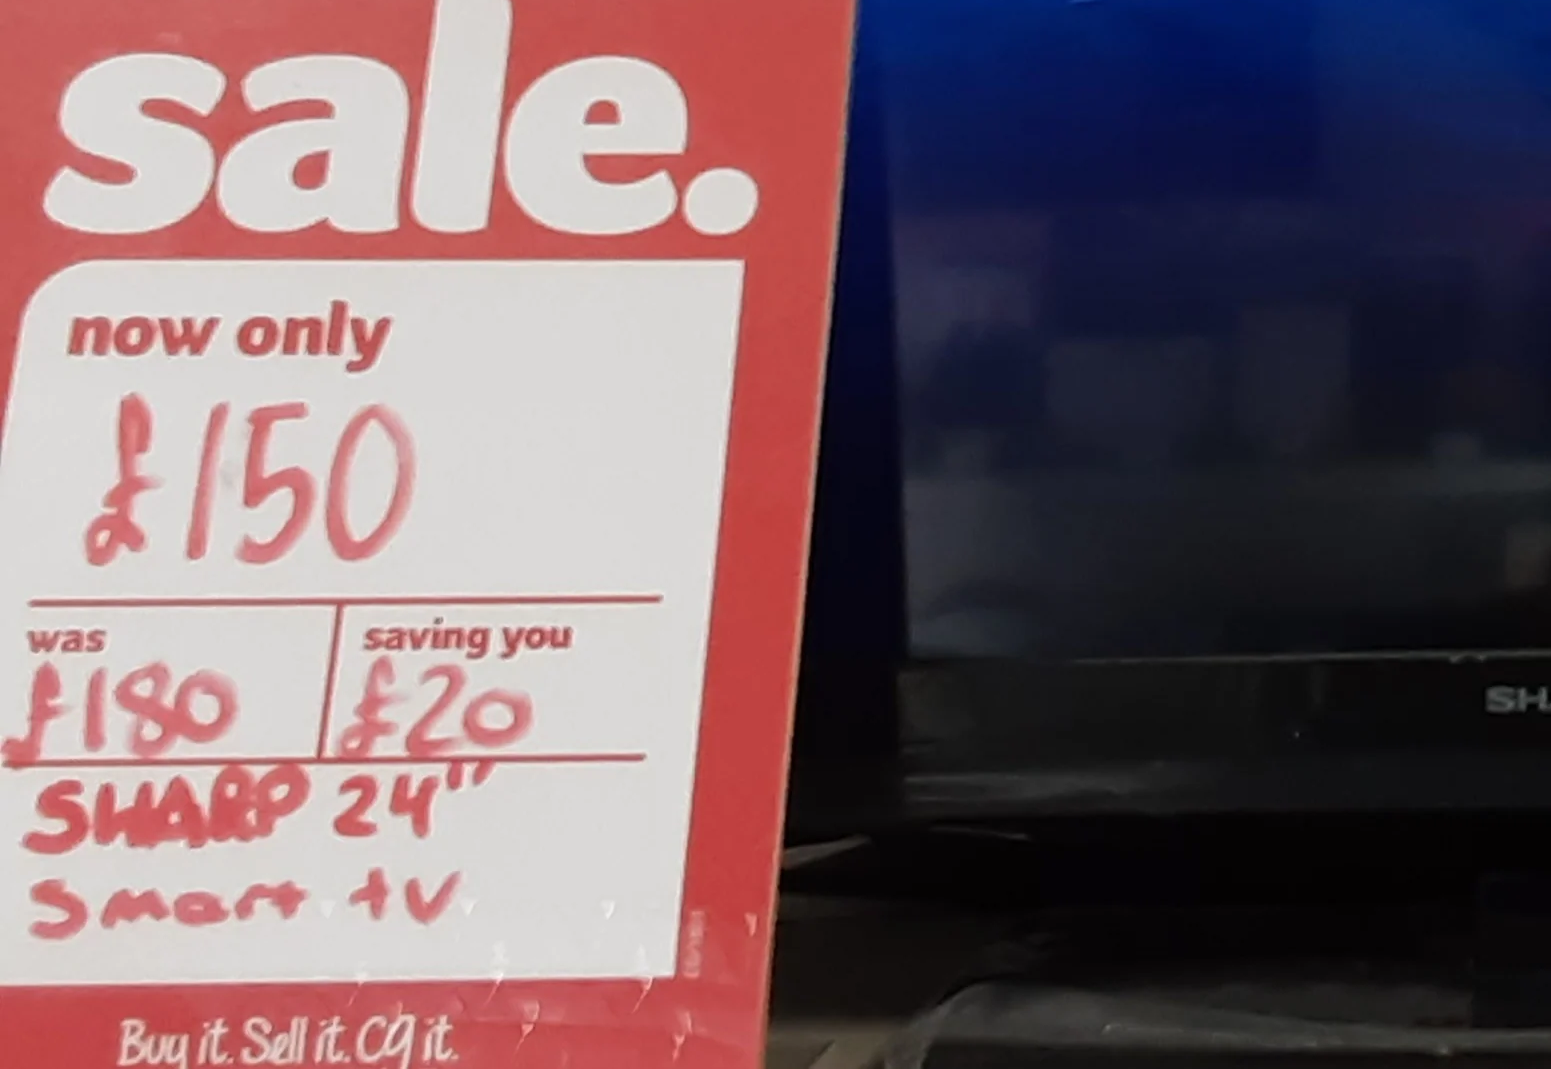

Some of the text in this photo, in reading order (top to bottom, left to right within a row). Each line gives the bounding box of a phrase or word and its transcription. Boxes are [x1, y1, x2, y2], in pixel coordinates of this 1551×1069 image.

[67, 300, 392, 373] now only
[84, 392, 418, 566] £150
[27, 627, 108, 654] was
[363, 617, 574, 660] saving you
[1, 660, 239, 769] £180
[336, 655, 536, 760] £20
[22, 762, 312, 855] SHARP
[117, 1018, 191, 1069] Buy
[197, 1017, 235, 1066] it.
[240, 1016, 309, 1066] Sell
[314, 1015, 351, 1066] it.
[422, 1014, 460, 1066] it.
